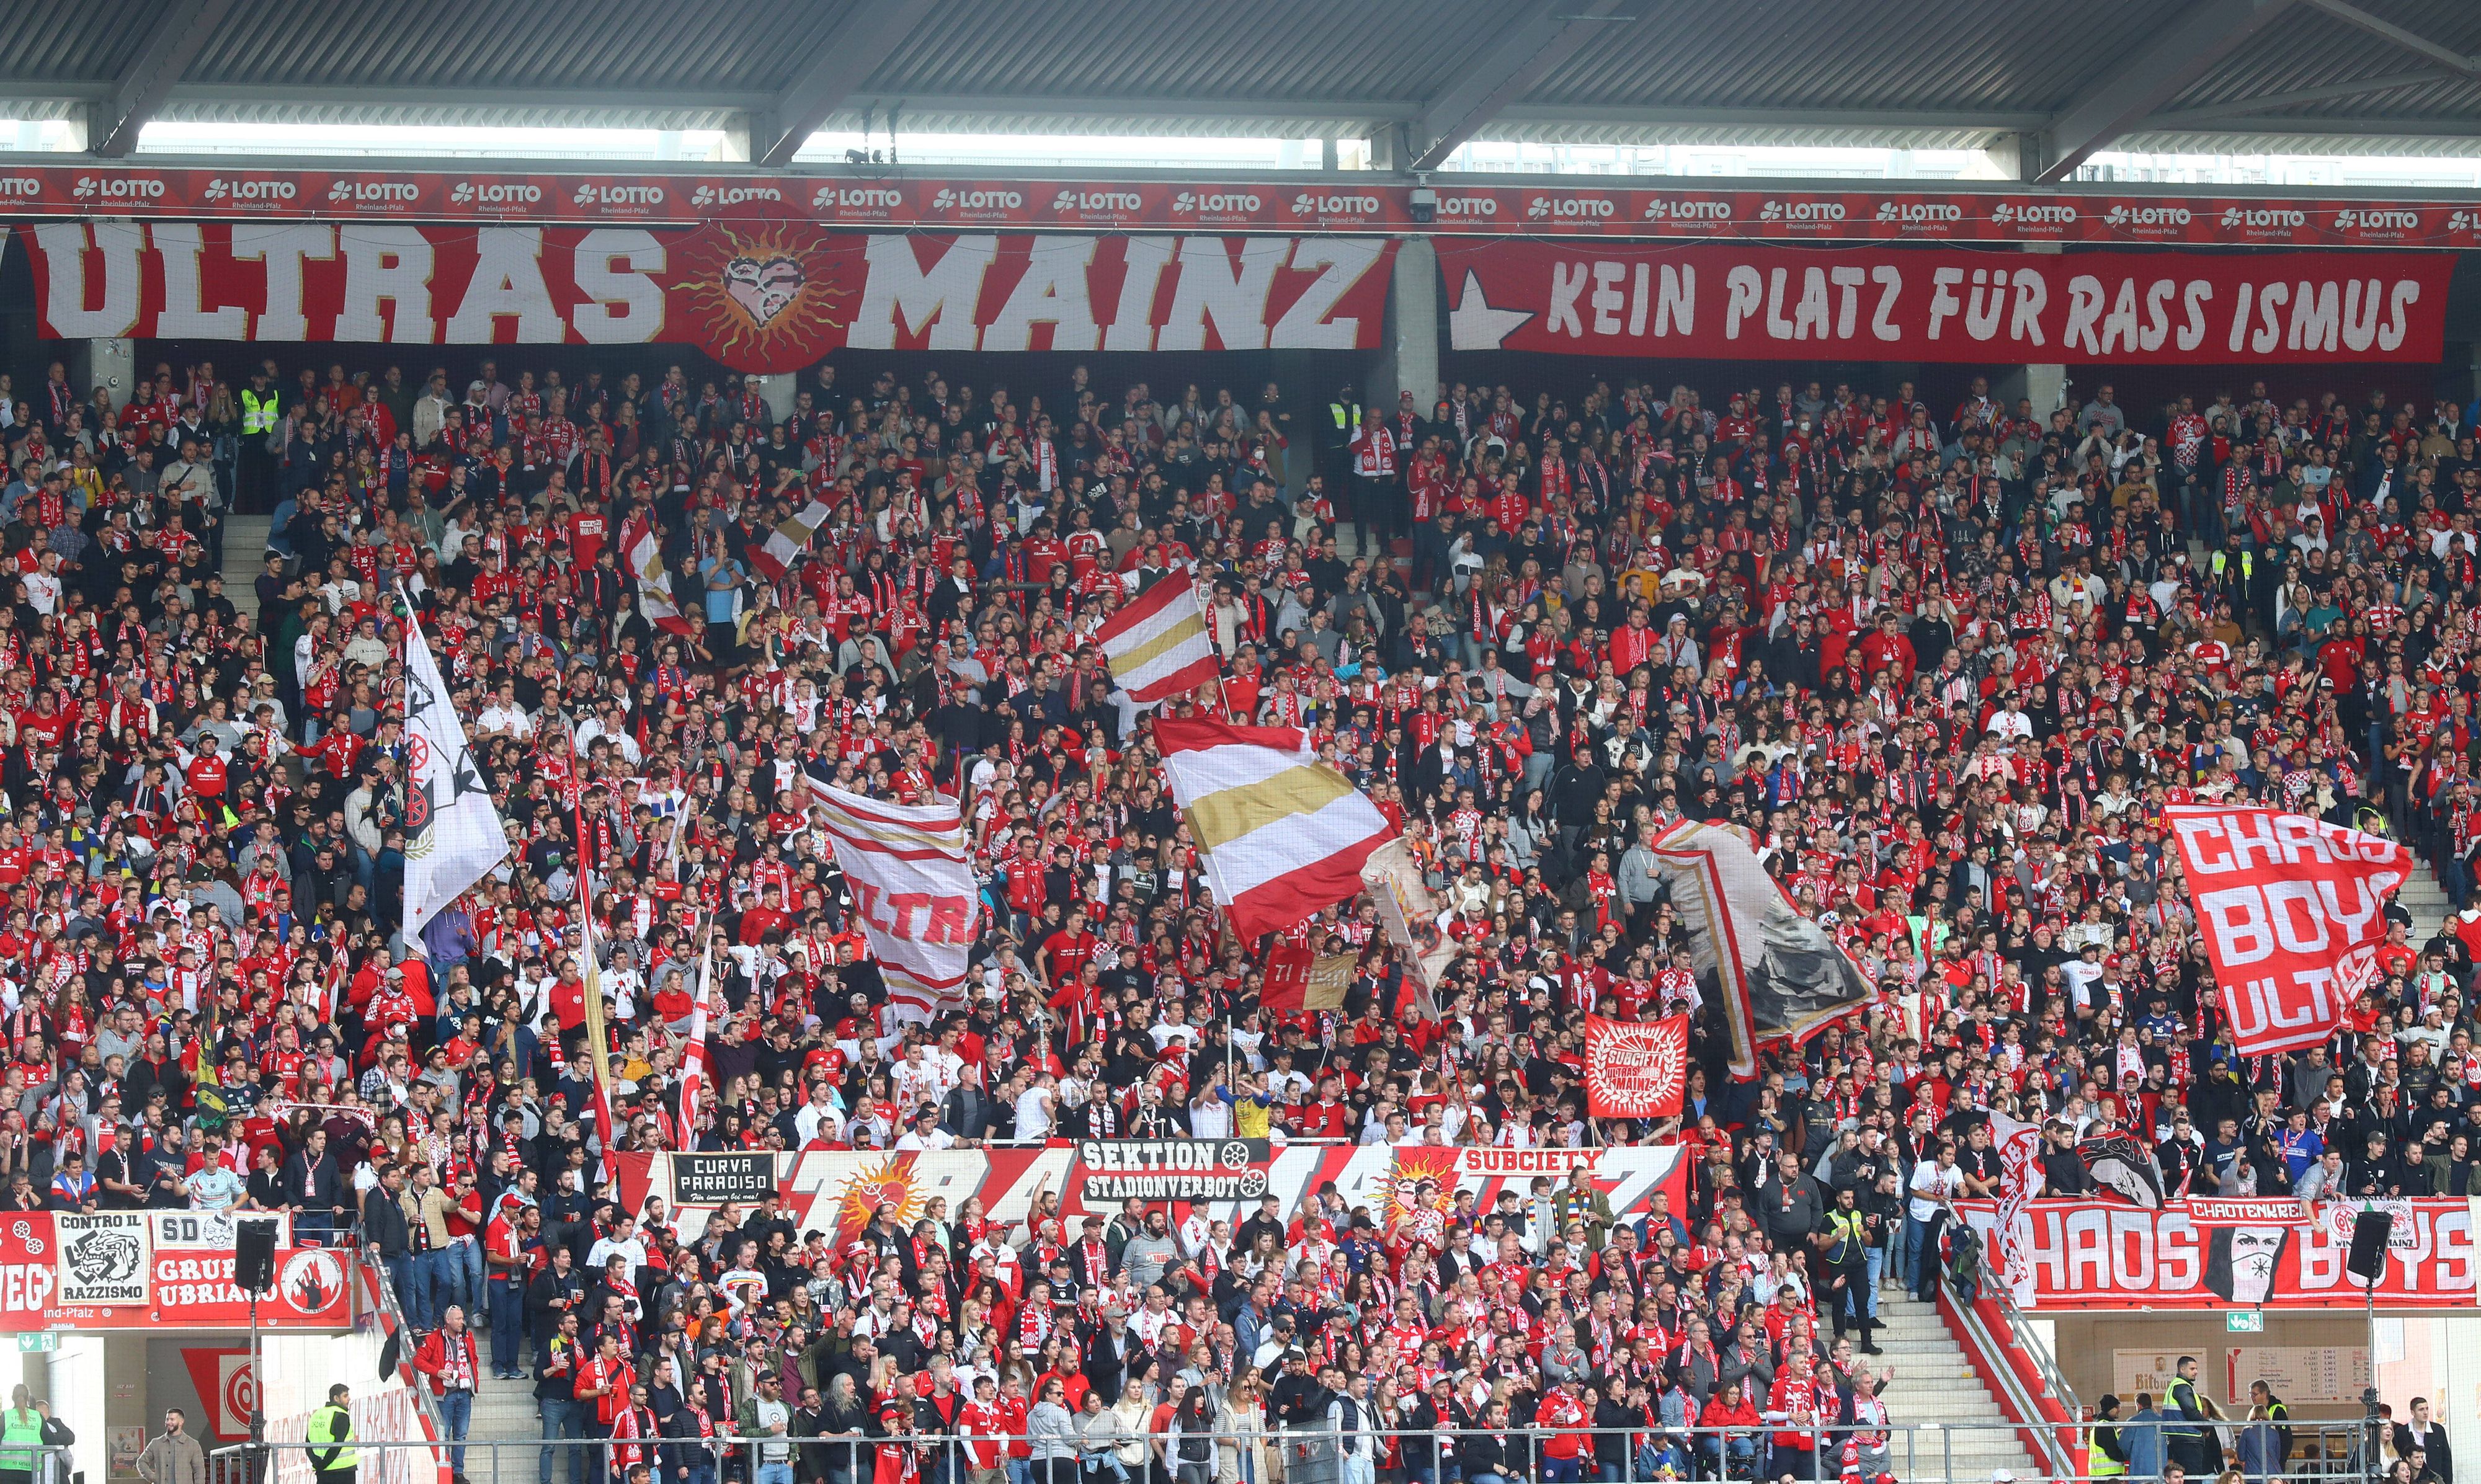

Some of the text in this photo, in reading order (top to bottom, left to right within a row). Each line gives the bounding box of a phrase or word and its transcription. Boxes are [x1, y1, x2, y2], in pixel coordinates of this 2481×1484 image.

[0, 179, 40, 195] TTO
[101, 179, 164, 197] LOTTO
[233, 182, 295, 198] LOTTO
[356, 183, 419, 200] LOTTO
[479, 185, 541, 202] LOTTO
[601, 187, 663, 203] LOTTO
[719, 188, 780, 204] LOTTO
[840, 189, 901, 206] LOTTO
[960, 190, 1022, 207] LOTTO
[1080, 192, 1141, 210] LOTTO
[1200, 194, 1260, 211] LOTTO
[1318, 196, 1379, 213] LOTTO
[1435, 197, 1497, 215] LOTTO
[1554, 199, 1614, 216] LOTTO
[1671, 201, 1730, 218] LOTTO
[1786, 203, 1845, 220] LOTTO
[1902, 205, 1961, 223] LOTTO
[2017, 206, 2076, 223] LOTTO
[2132, 208, 2191, 224] LOTTO
[2247, 210, 2305, 227] LOTTO
[2360, 211, 2418, 228] LOTTO
[33, 223, 666, 344] ULTRAS
[846, 234, 1387, 351] MAINZ
[1548, 261, 2419, 355] KEIN PLATZ FÜR RASS ISMUS
[1607, 1067, 1637, 1078] ULTRAS
[1083, 1141, 1216, 1171] SEKTION
[1466, 1150, 1599, 1171] SUBCIETY
[694, 1158, 752, 1174] CURVA
[680, 1175, 767, 1190] PARADISO
[1087, 1175, 1240, 1197] STADIONVERBOT
[730, 1193, 741, 1201] bei
[2193, 1202, 2306, 1220] CHAOTENKREI
[61, 1214, 142, 1229] CONTRO IL
[163, 1216, 199, 1242] SD
[157, 1258, 277, 1282] GRUP
[0, 1263, 43, 1312] EG
[64, 1286, 143, 1300] RAZZISMO
